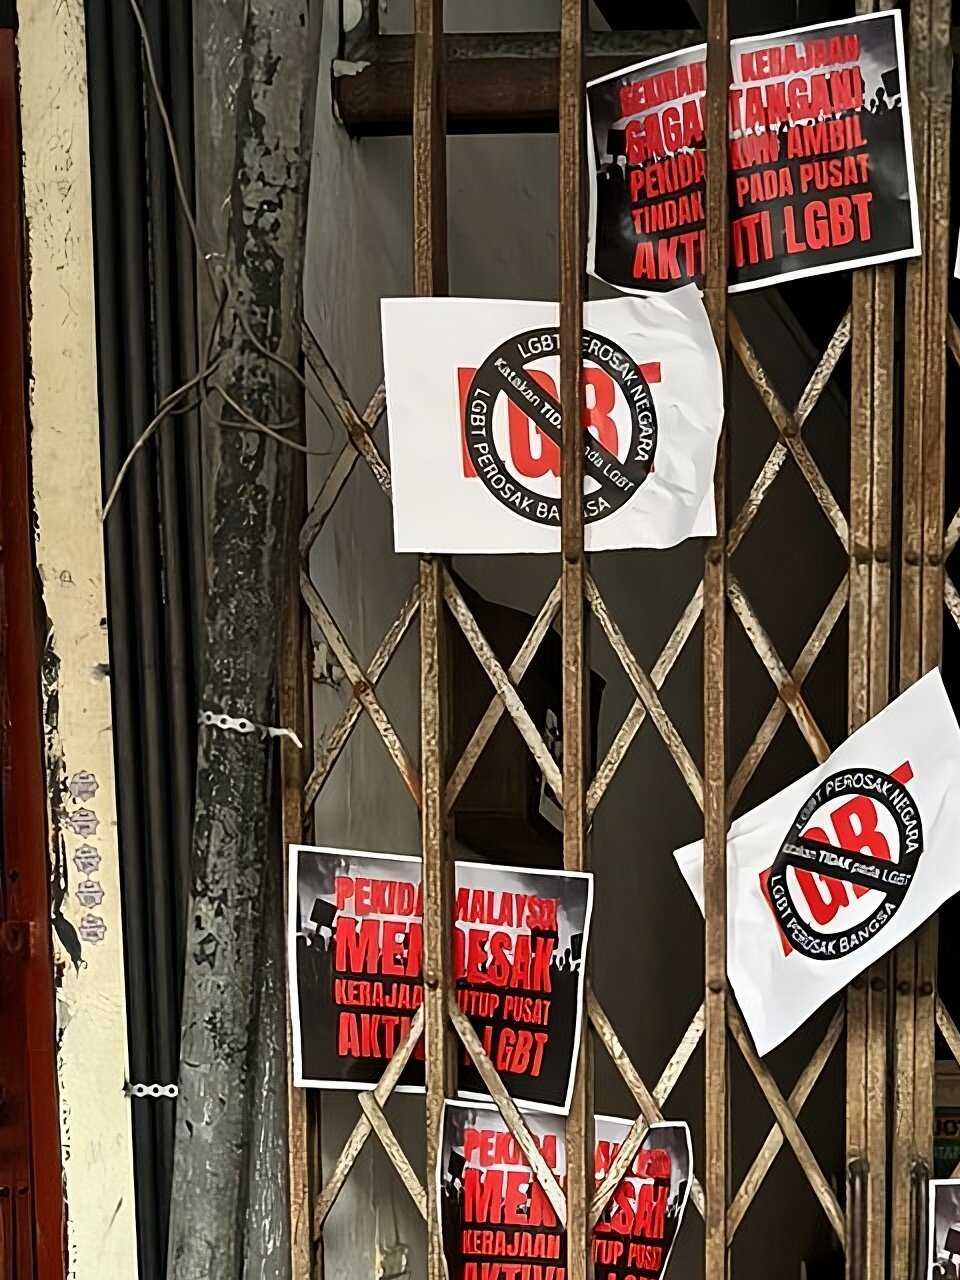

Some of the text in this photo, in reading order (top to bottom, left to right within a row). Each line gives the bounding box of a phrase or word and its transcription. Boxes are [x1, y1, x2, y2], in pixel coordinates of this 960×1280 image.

[624, 97, 706, 165] GAGA
[787, 115, 867, 159] AMBIL
[632, 154, 869, 234] TINDAK PADA PUSAT
[633, 193, 872, 281] AKTIITI LGBT
[583, 337, 638, 387] EROSAK
[630, 385, 653, 461] NEGARA
[471, 388, 611, 521] LGBT PEROSAK BASA
[540, 403, 562, 430] TID
[603, 464, 635, 492] LGBT
[826, 773, 892, 796] PEROSAK
[890, 791, 919, 854] NEGARA
[771, 875, 793, 918] LGBT
[839, 902, 896, 953] BANGSA
[335, 979, 423, 1009] KERAJAA
[503, 995, 551, 1026] PUSAT
[463, 1230, 560, 1259] KERAJAAN
